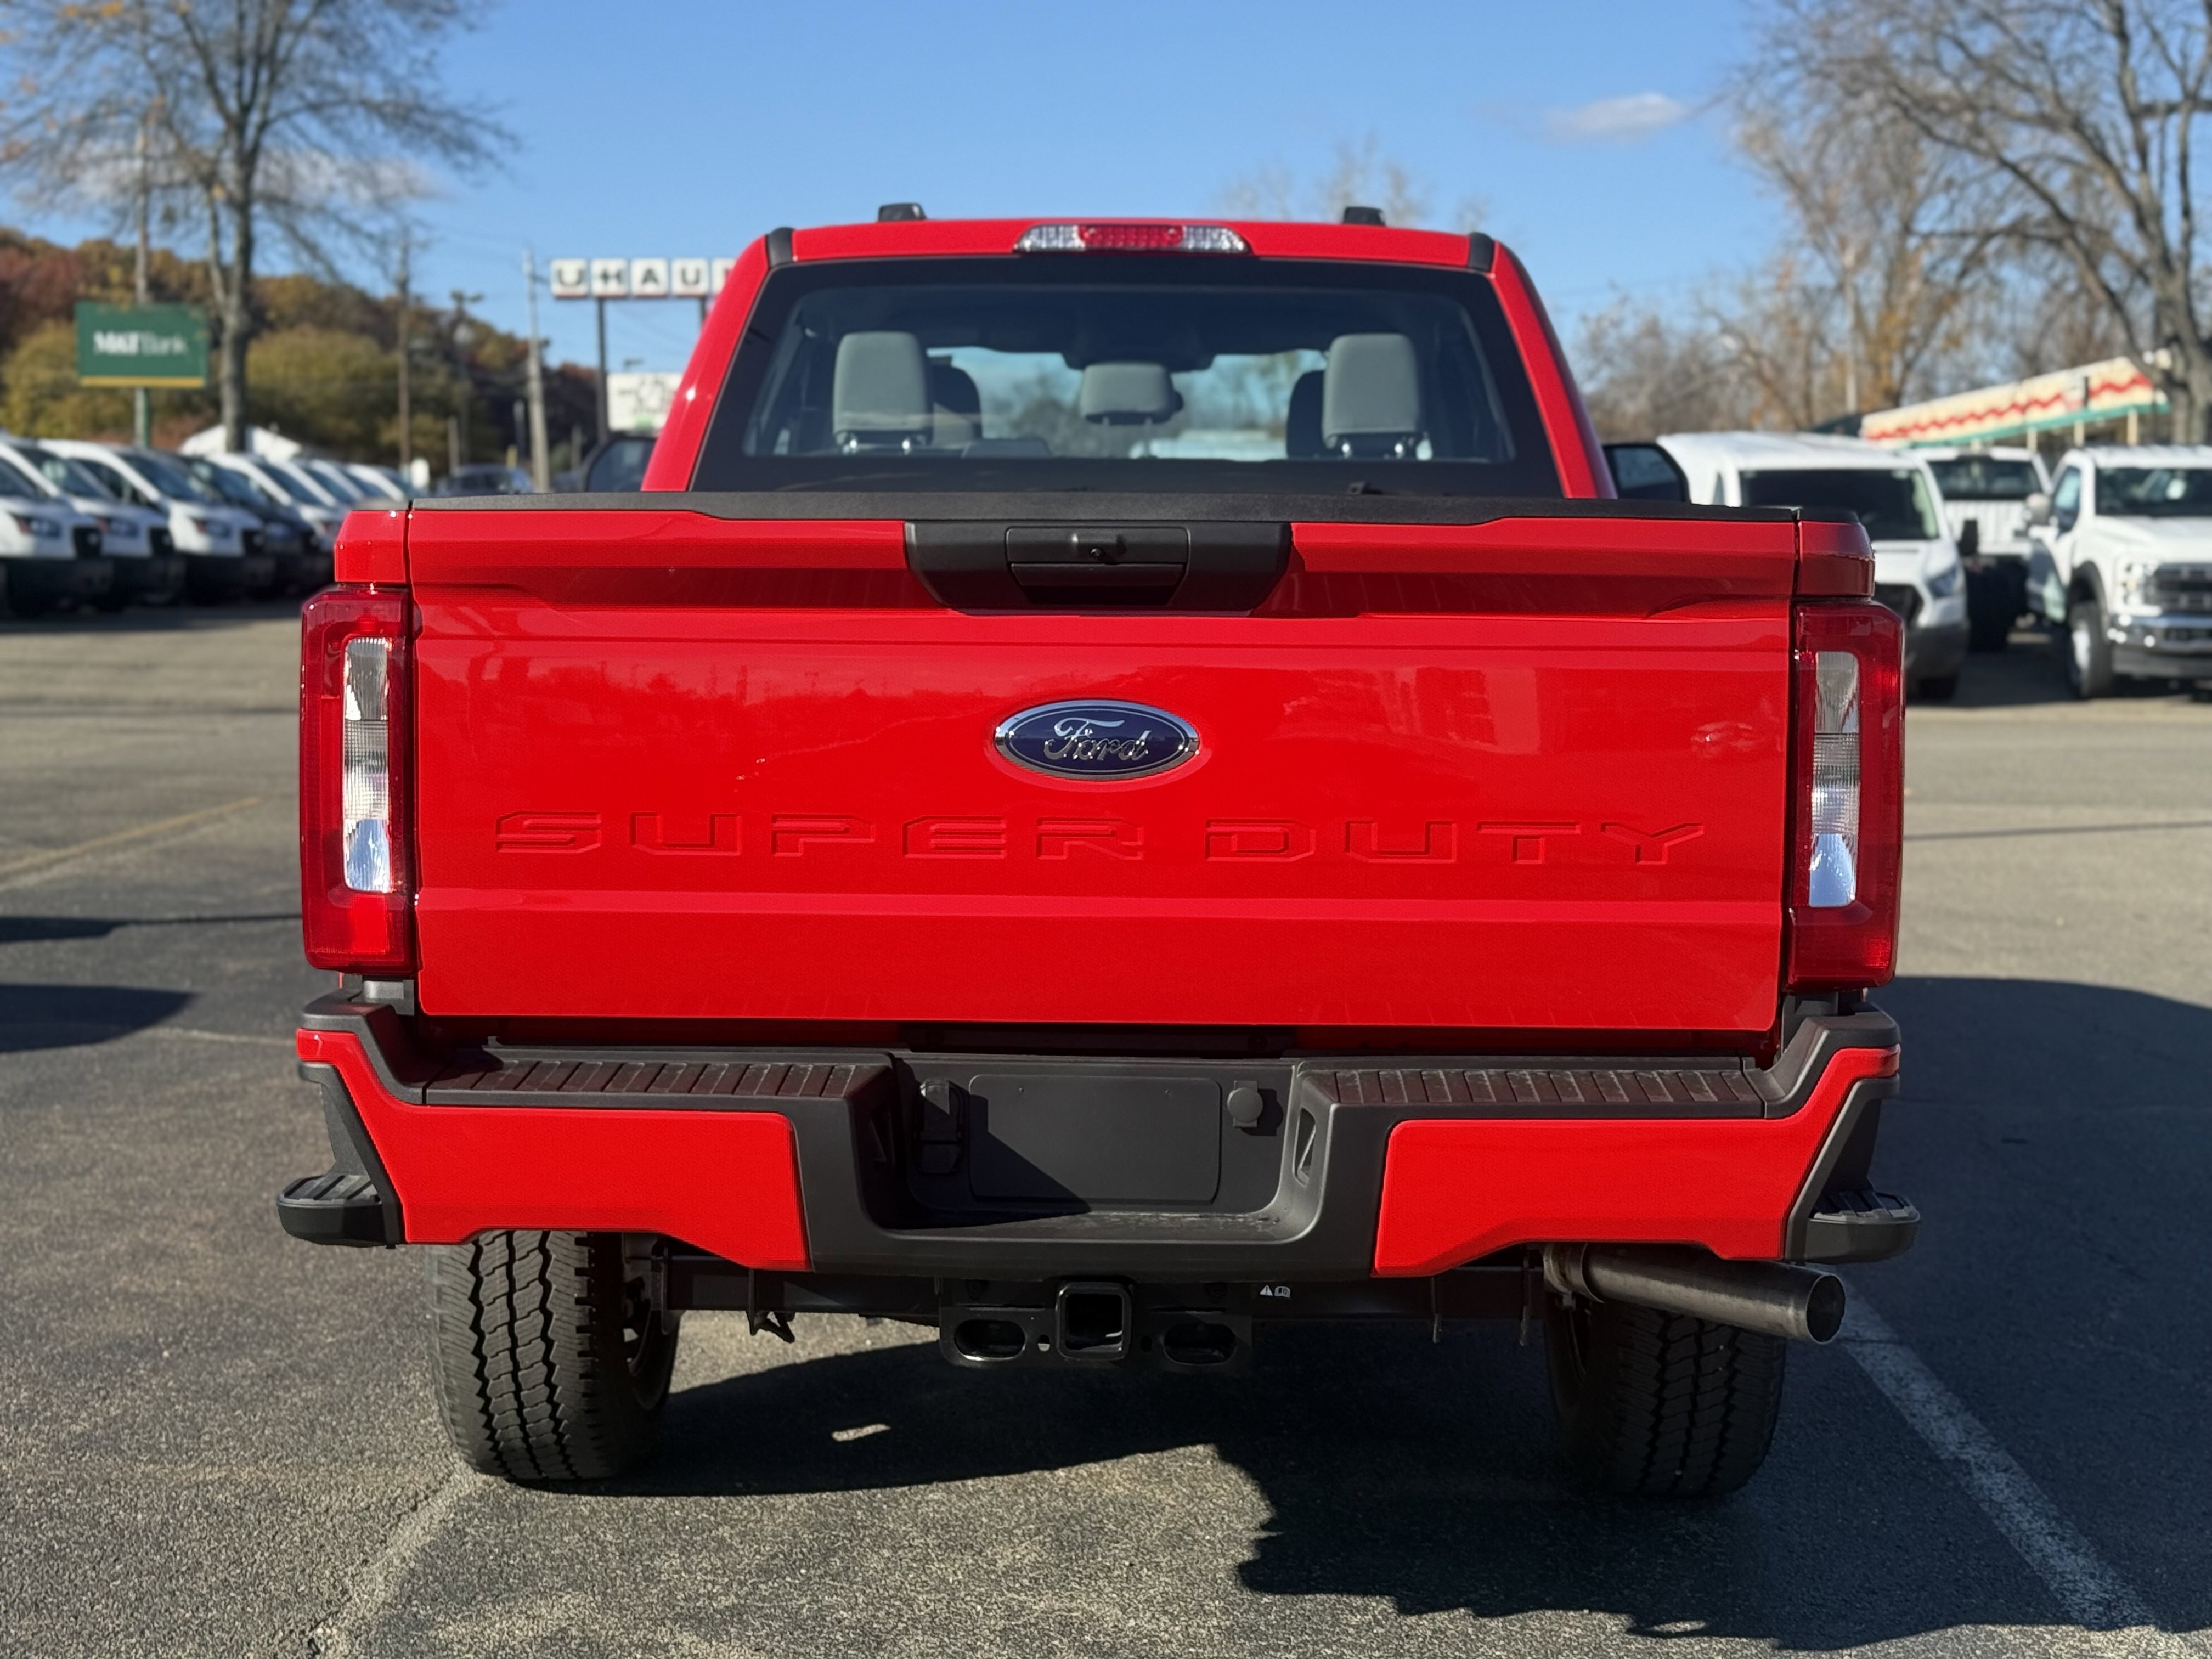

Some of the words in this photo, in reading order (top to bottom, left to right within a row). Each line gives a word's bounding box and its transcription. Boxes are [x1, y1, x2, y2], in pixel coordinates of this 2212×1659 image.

[1043, 716, 1152, 761] Ford
[495, 810, 1144, 861] SUPER
[1205, 818, 1706, 865] DUTY
